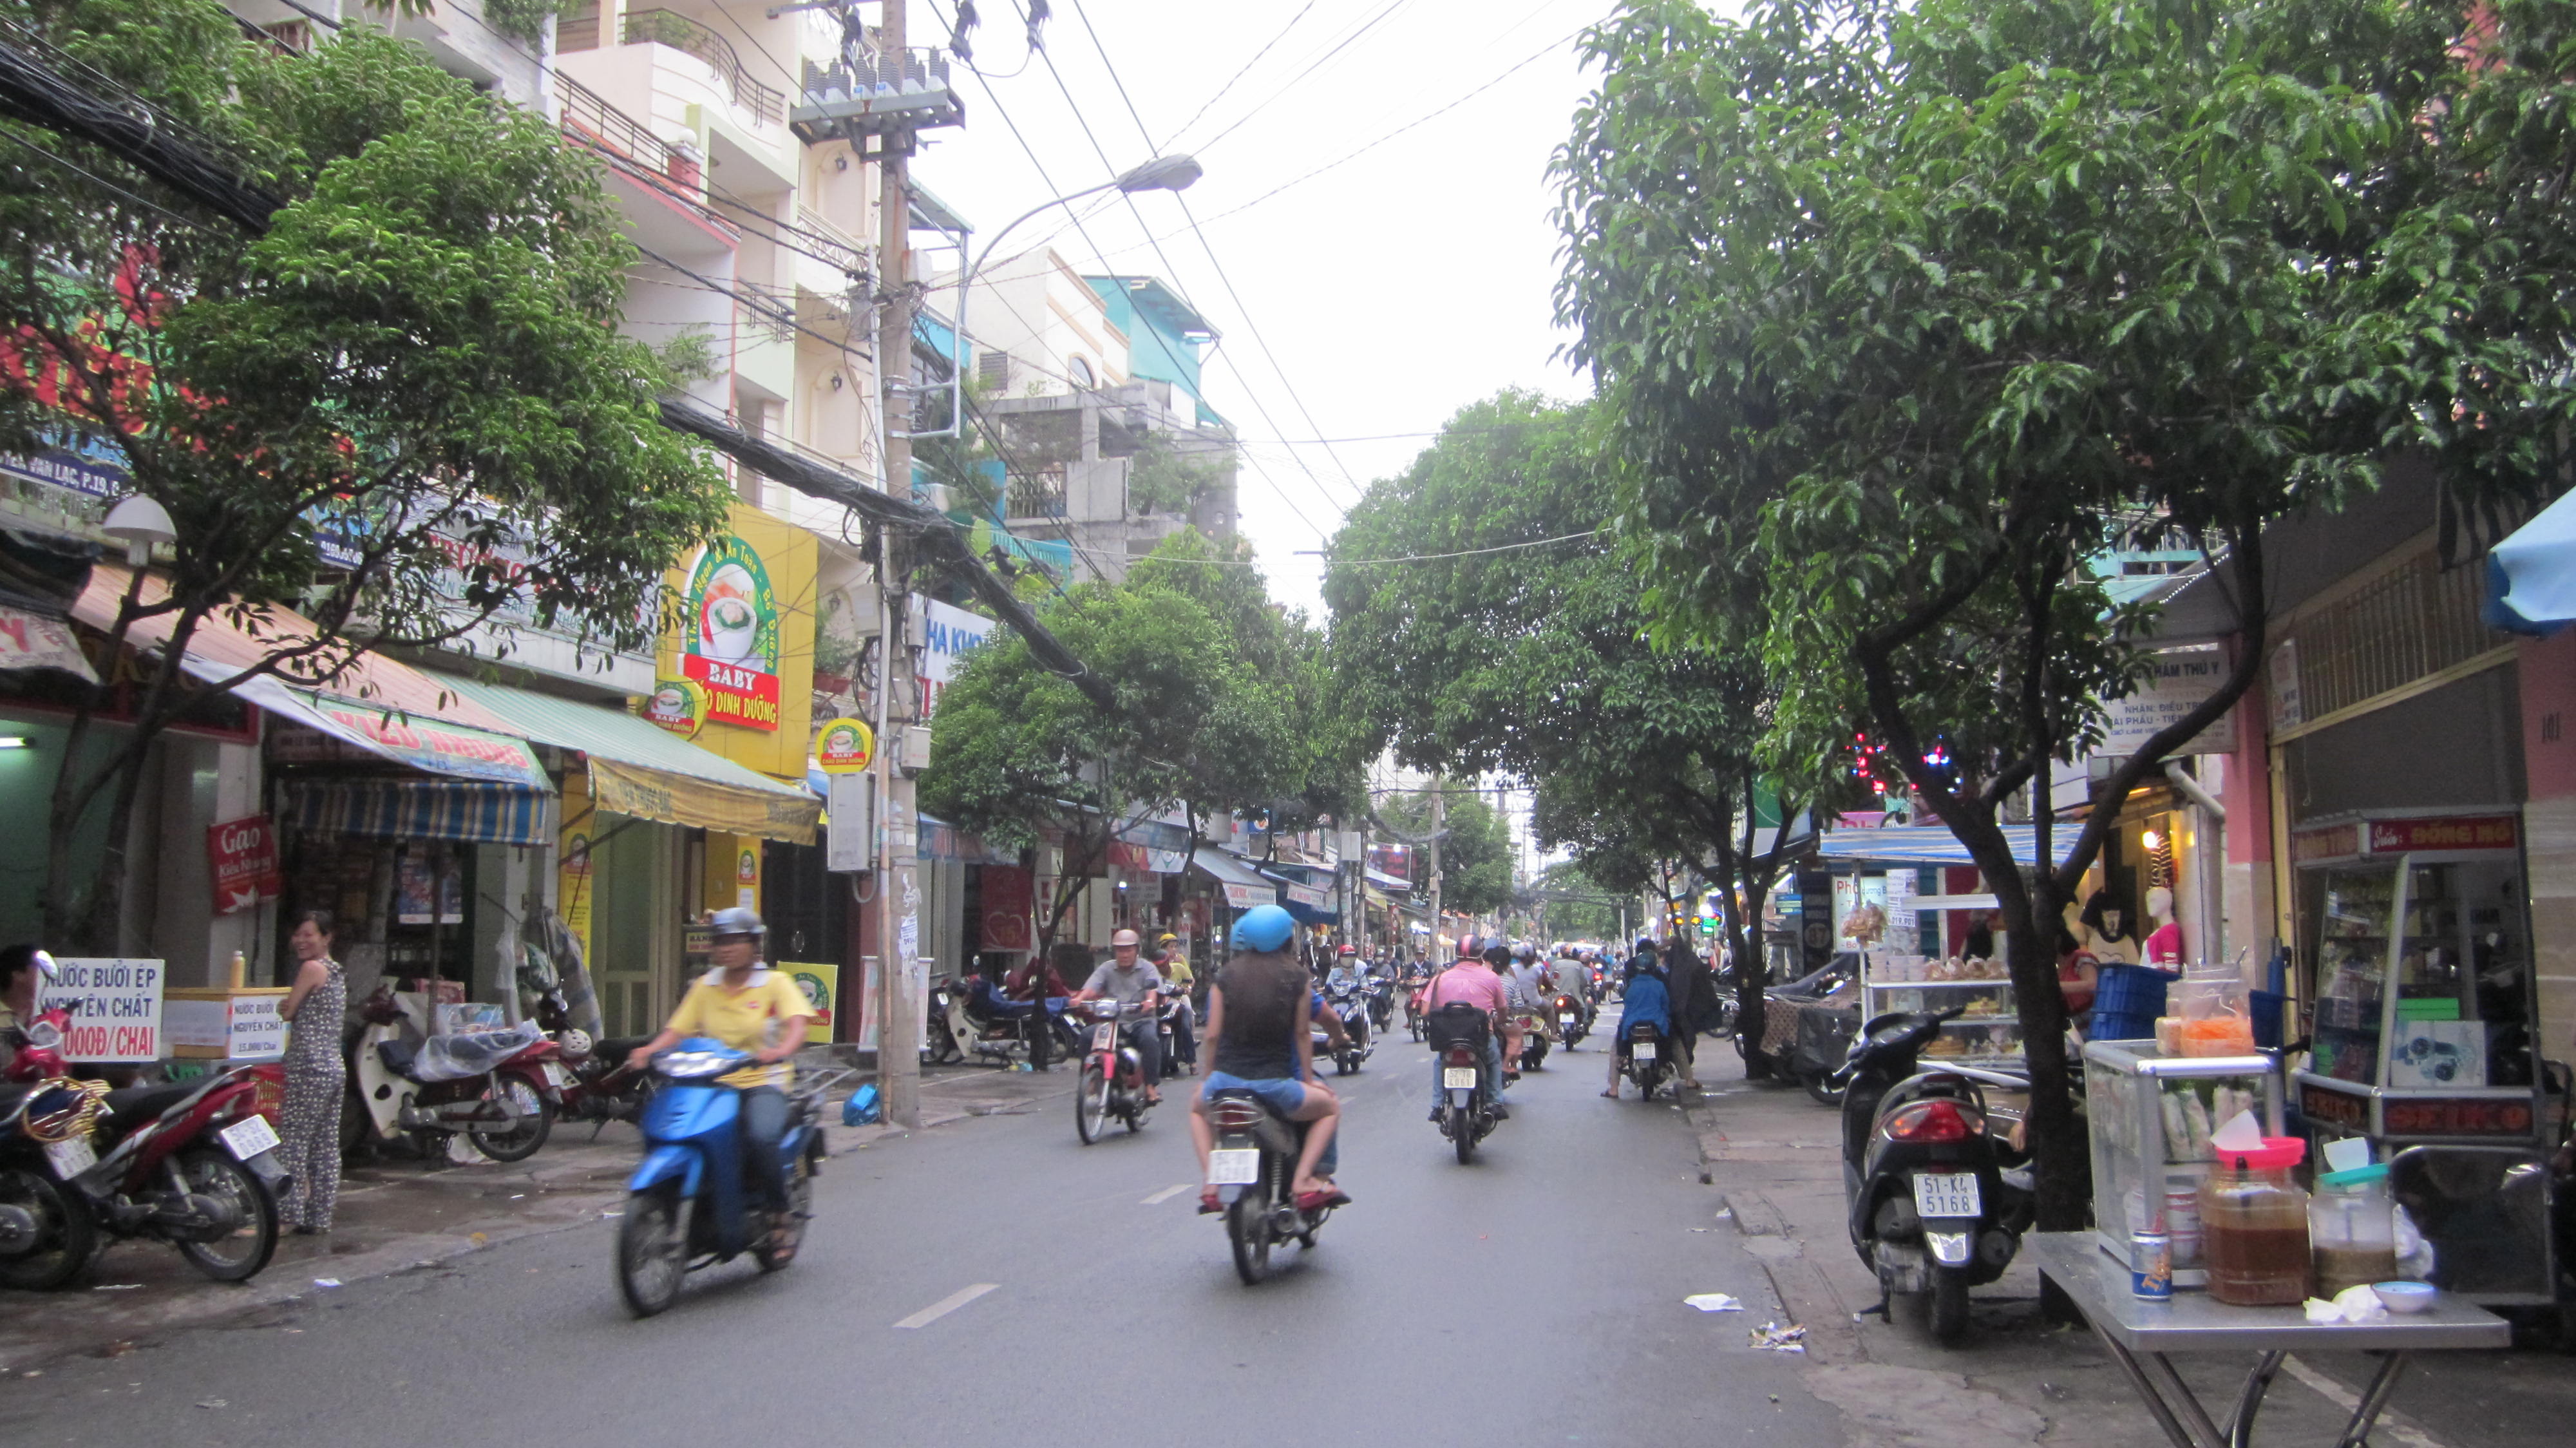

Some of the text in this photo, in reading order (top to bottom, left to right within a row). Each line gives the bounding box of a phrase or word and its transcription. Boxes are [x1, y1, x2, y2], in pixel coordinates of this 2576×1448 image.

[927, 618, 989, 656] HA KHO
[708, 663, 757, 691] BABY
[655, 714, 681, 723] BABY
[716, 691, 741, 716] DINH
[743, 694, 777, 724] DƯỠNG
[221, 824, 261, 857] Gạo
[93, 960, 130, 987] BƯỞI
[136, 964, 156, 987] ÉP
[112, 991, 153, 1017] CHẤT
[1924, 1176, 1968, 1194] 51-K4
[1926, 1195, 1970, 1213] 5168
